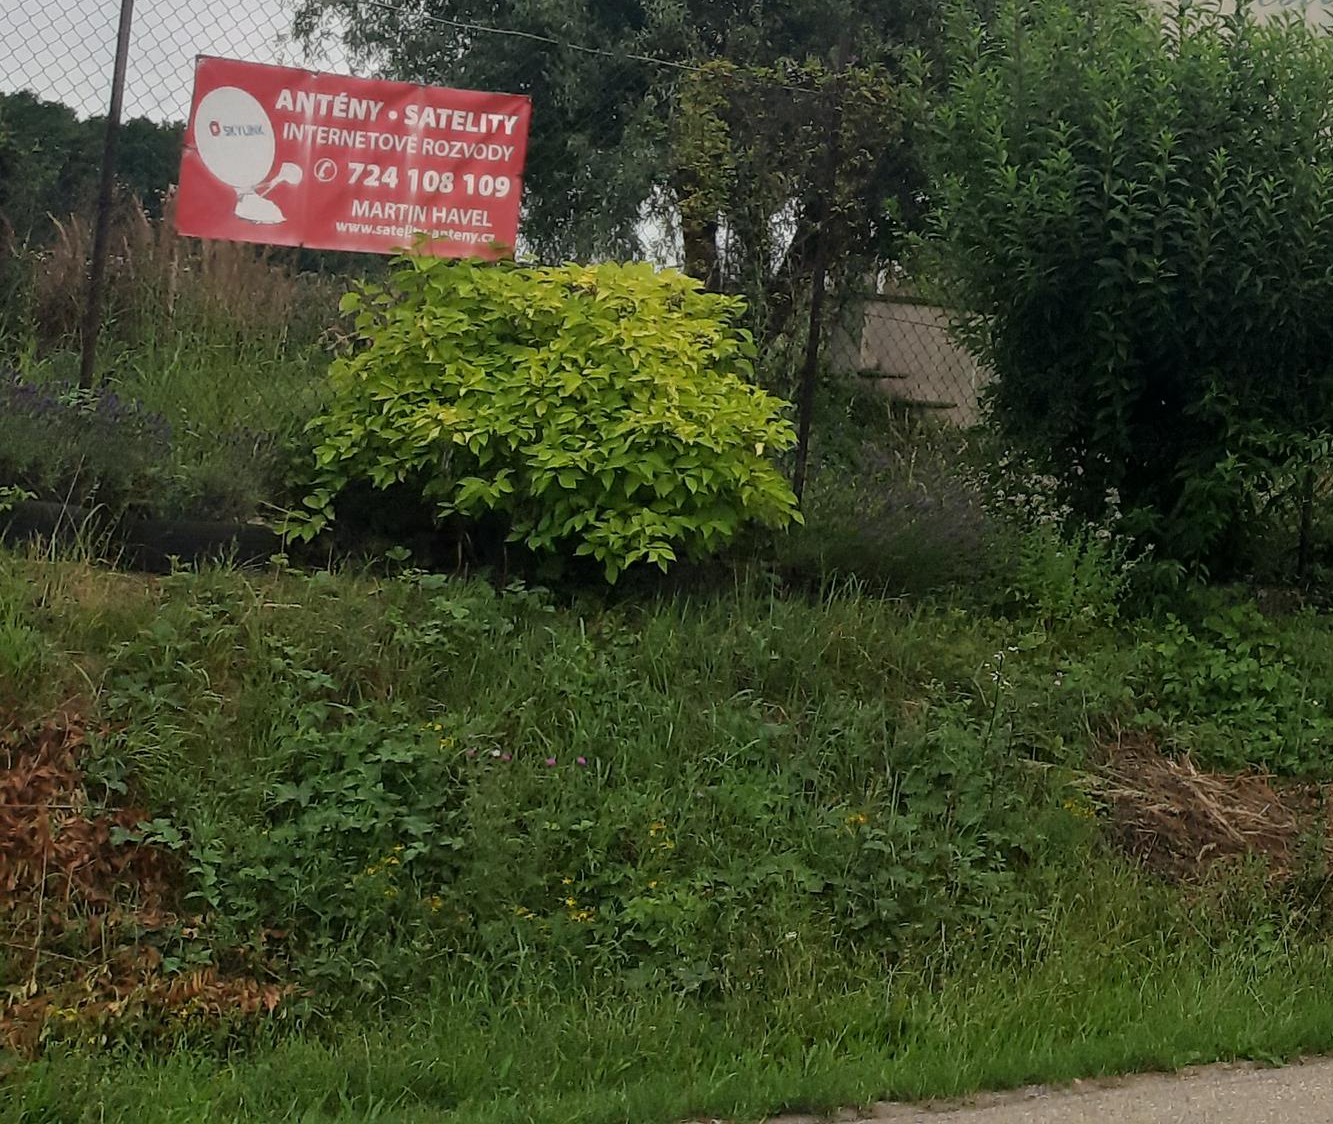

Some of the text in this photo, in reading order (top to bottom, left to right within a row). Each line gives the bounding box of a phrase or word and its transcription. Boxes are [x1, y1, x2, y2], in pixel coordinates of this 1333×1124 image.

[275, 88, 518, 135] ANTÉNY SATELITY
[282, 122, 514, 162] INTERNETOVÉ ROZVODY
[348, 162, 511, 198] 724 108 109
[351, 199, 493, 227] MARTIN HAVEL
